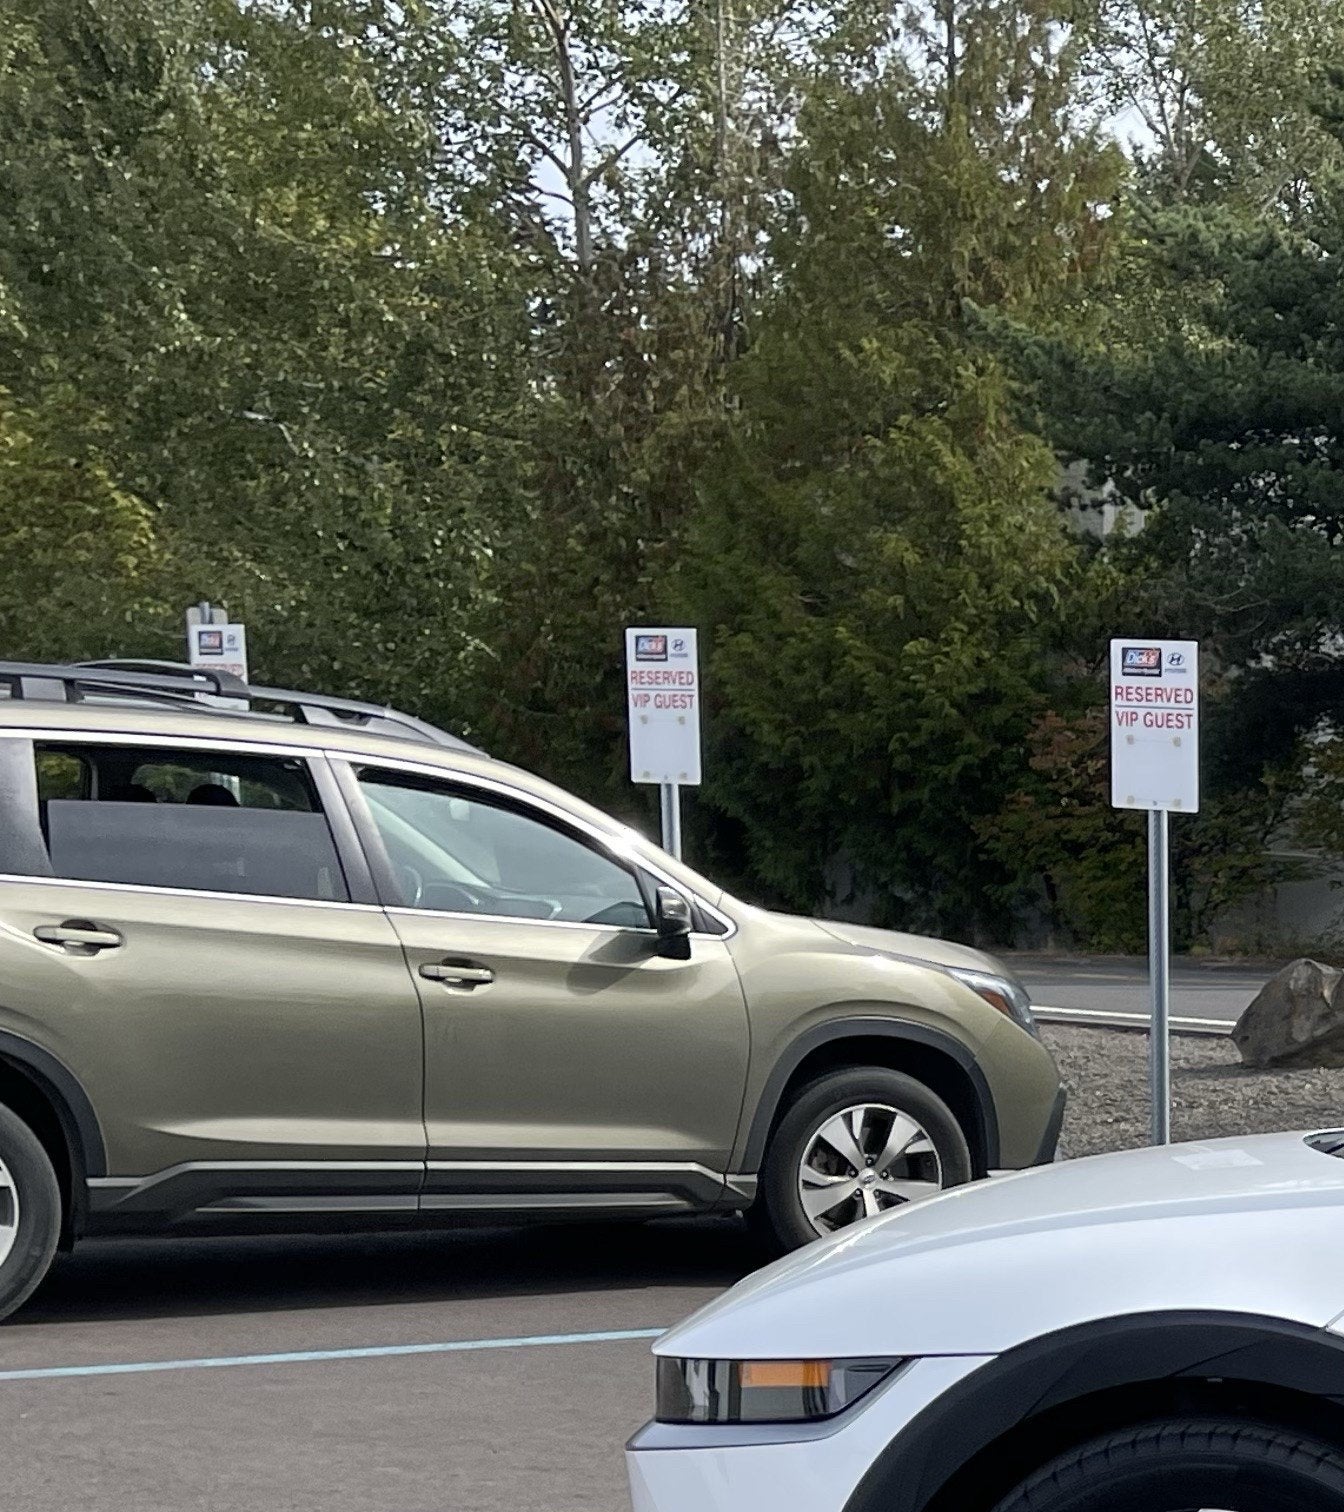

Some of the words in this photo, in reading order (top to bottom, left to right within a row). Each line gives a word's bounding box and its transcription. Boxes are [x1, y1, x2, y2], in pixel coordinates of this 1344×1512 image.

[630, 670, 695, 686] RESERVED
[631, 693, 651, 708] VIP
[653, 693, 695, 710] GUEST
[1114, 685, 1194, 704] RESERVED
[1115, 710, 1139, 727] VIP
[1143, 711, 1194, 729] GUEST
